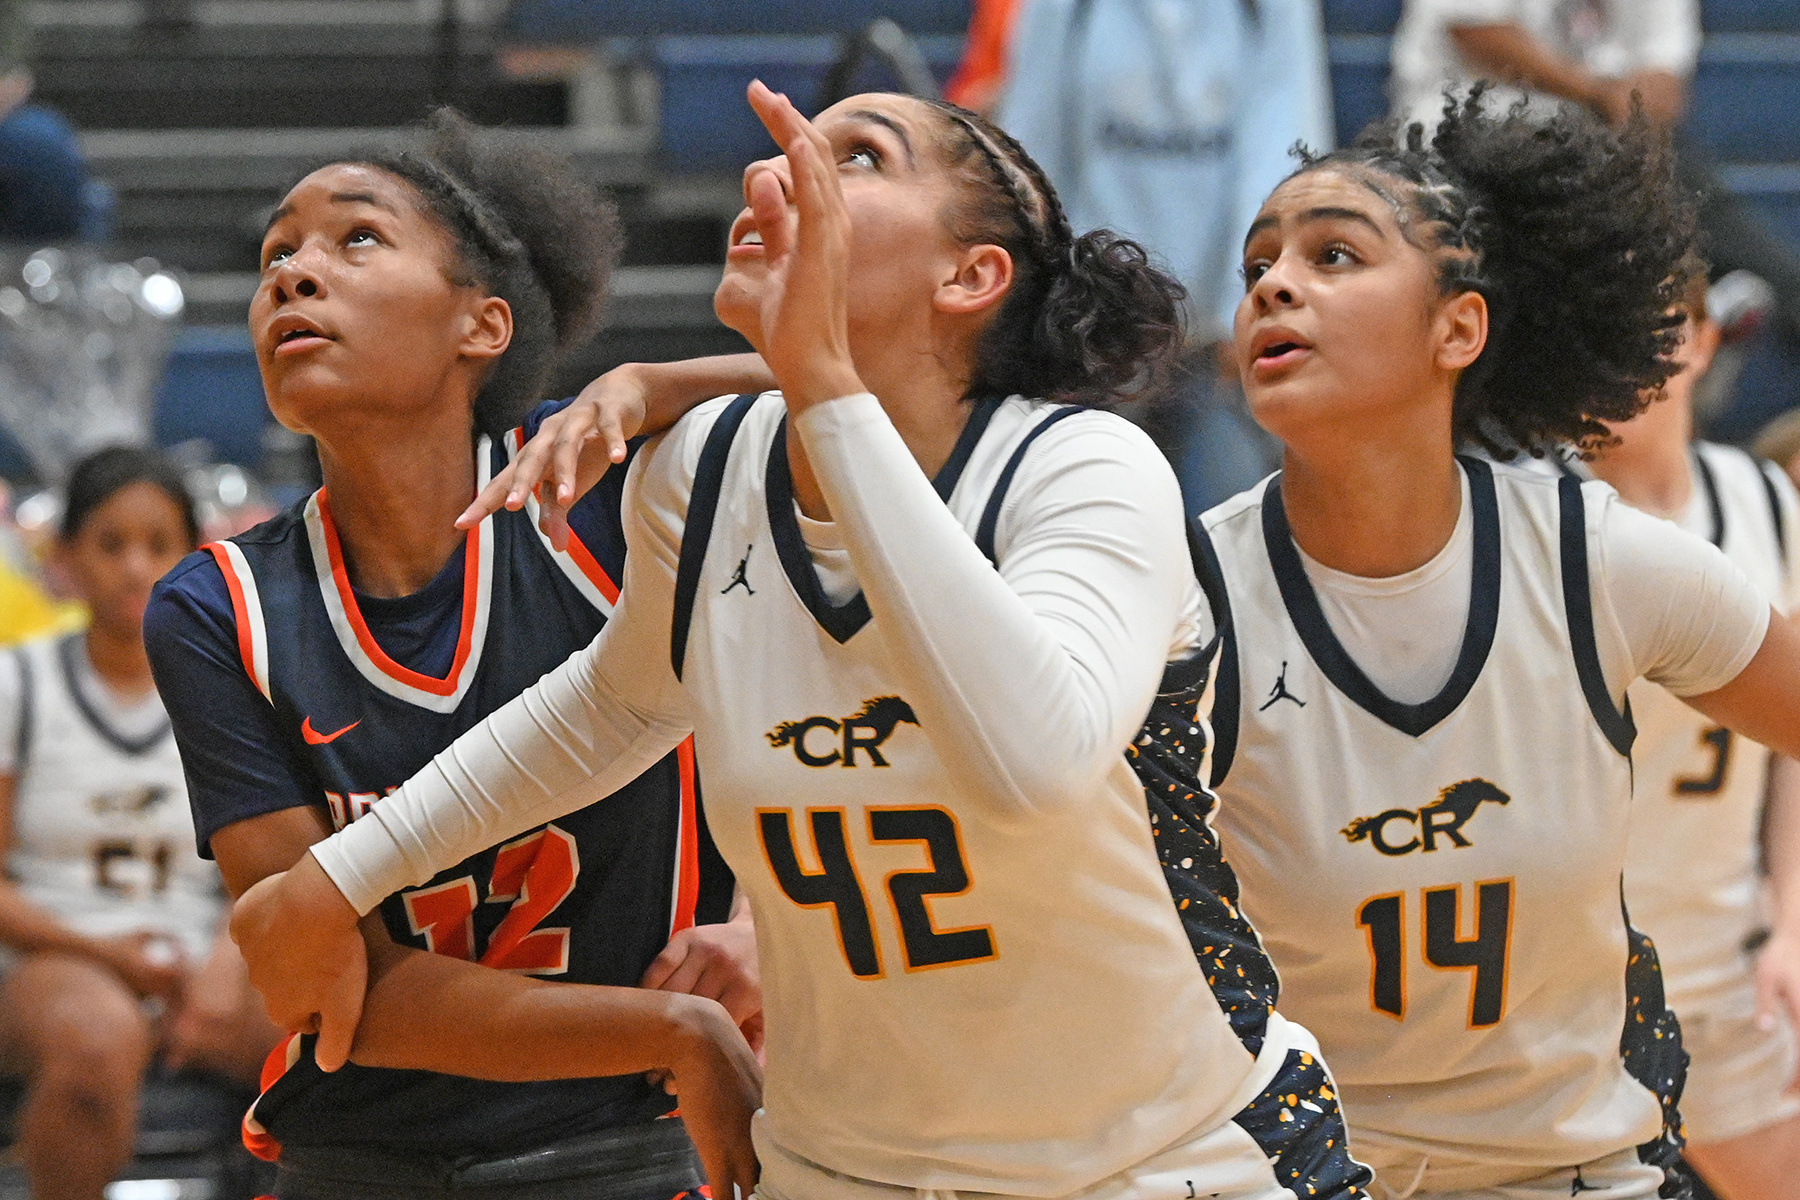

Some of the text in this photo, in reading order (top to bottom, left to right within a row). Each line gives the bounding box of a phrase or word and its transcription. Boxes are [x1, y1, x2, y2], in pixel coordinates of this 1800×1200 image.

[793, 715, 891, 768] CR
[402, 823, 580, 976] 12
[754, 803, 1000, 981] 42
[1370, 807, 1474, 857] CR
[1354, 875, 1516, 1031] 14
